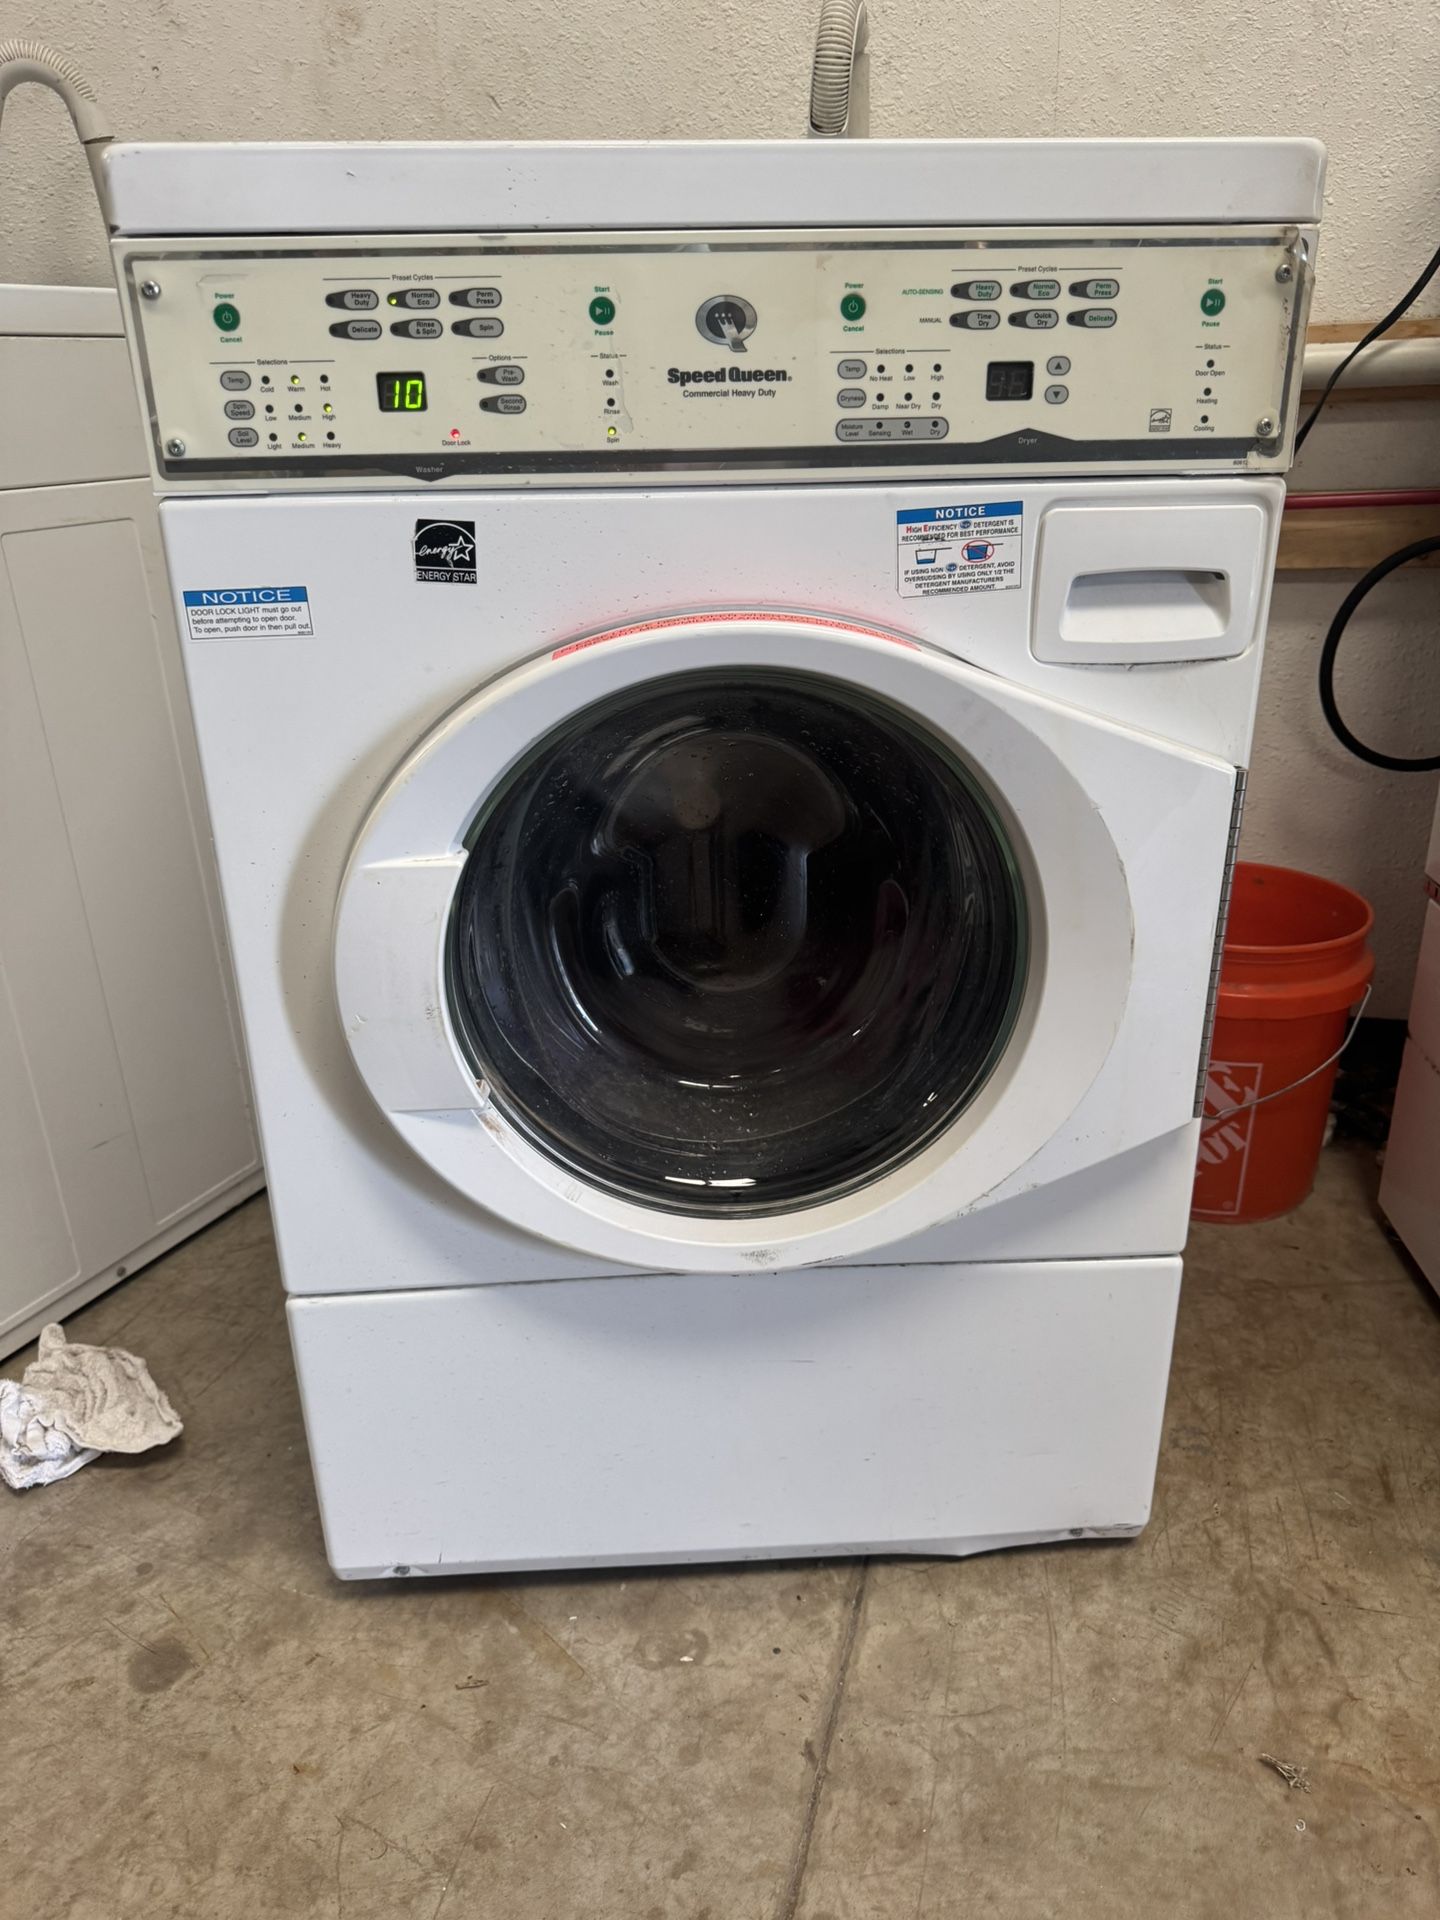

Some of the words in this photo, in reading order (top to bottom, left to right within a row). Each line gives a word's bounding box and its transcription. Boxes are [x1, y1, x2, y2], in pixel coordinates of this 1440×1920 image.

[1037, 265, 1058, 273] Cycles
[412, 273, 434, 282] Cycles
[975, 283, 995, 291] Heavy
[214, 292, 235, 300] Power
[351, 292, 371, 300] Heavy
[411, 291, 435, 299] Normal
[476, 290, 494, 298] Perm
[977, 290, 993, 298] Duty
[354, 299, 369, 307] Duty
[978, 319, 990, 327] Dry
[1037, 319, 1048, 327] Dry
[1201, 320, 1220, 328] Pause
[422, 328, 437, 336] Spin
[479, 324, 494, 332] Spin
[488, 354, 512, 362] Options
[599, 352, 619, 360] Status
[256, 358, 288, 366] Selections
[667, 367, 726, 386] Speed
[1210, 369, 1226, 378] Open
[930, 374, 944, 382] High
[394, 380, 423, 409] 10
[682, 388, 730, 398] Commercial
[731, 388, 756, 398] Heavy
[758, 387, 776, 398] Duty
[500, 397, 523, 405] Second
[232, 403, 247, 411] Spin
[910, 402, 922, 410] Dry
[931, 402, 942, 410] Dry
[322, 414, 336, 422] High
[606, 436, 620, 444] Spin
[1018, 437, 1038, 445] Dryer
[935, 506, 986, 519] NOTICE
[923, 524, 957, 533] EFFICIENCY
[973, 520, 1007, 528] DETERGENT
[975, 527, 1018, 536] PERFORMANCE
[417, 570, 451, 581] ENERGY
[453, 572, 476, 582] STAR
[915, 581, 950, 589] DETERGENT
[951, 577, 1004, 586] MANUFACTURERS
[922, 587, 969, 595] RECOMMENDED
[202, 589, 292, 604] NOTICE
[238, 607, 260, 615] LIGHT
[215, 617, 251, 625] attempting
